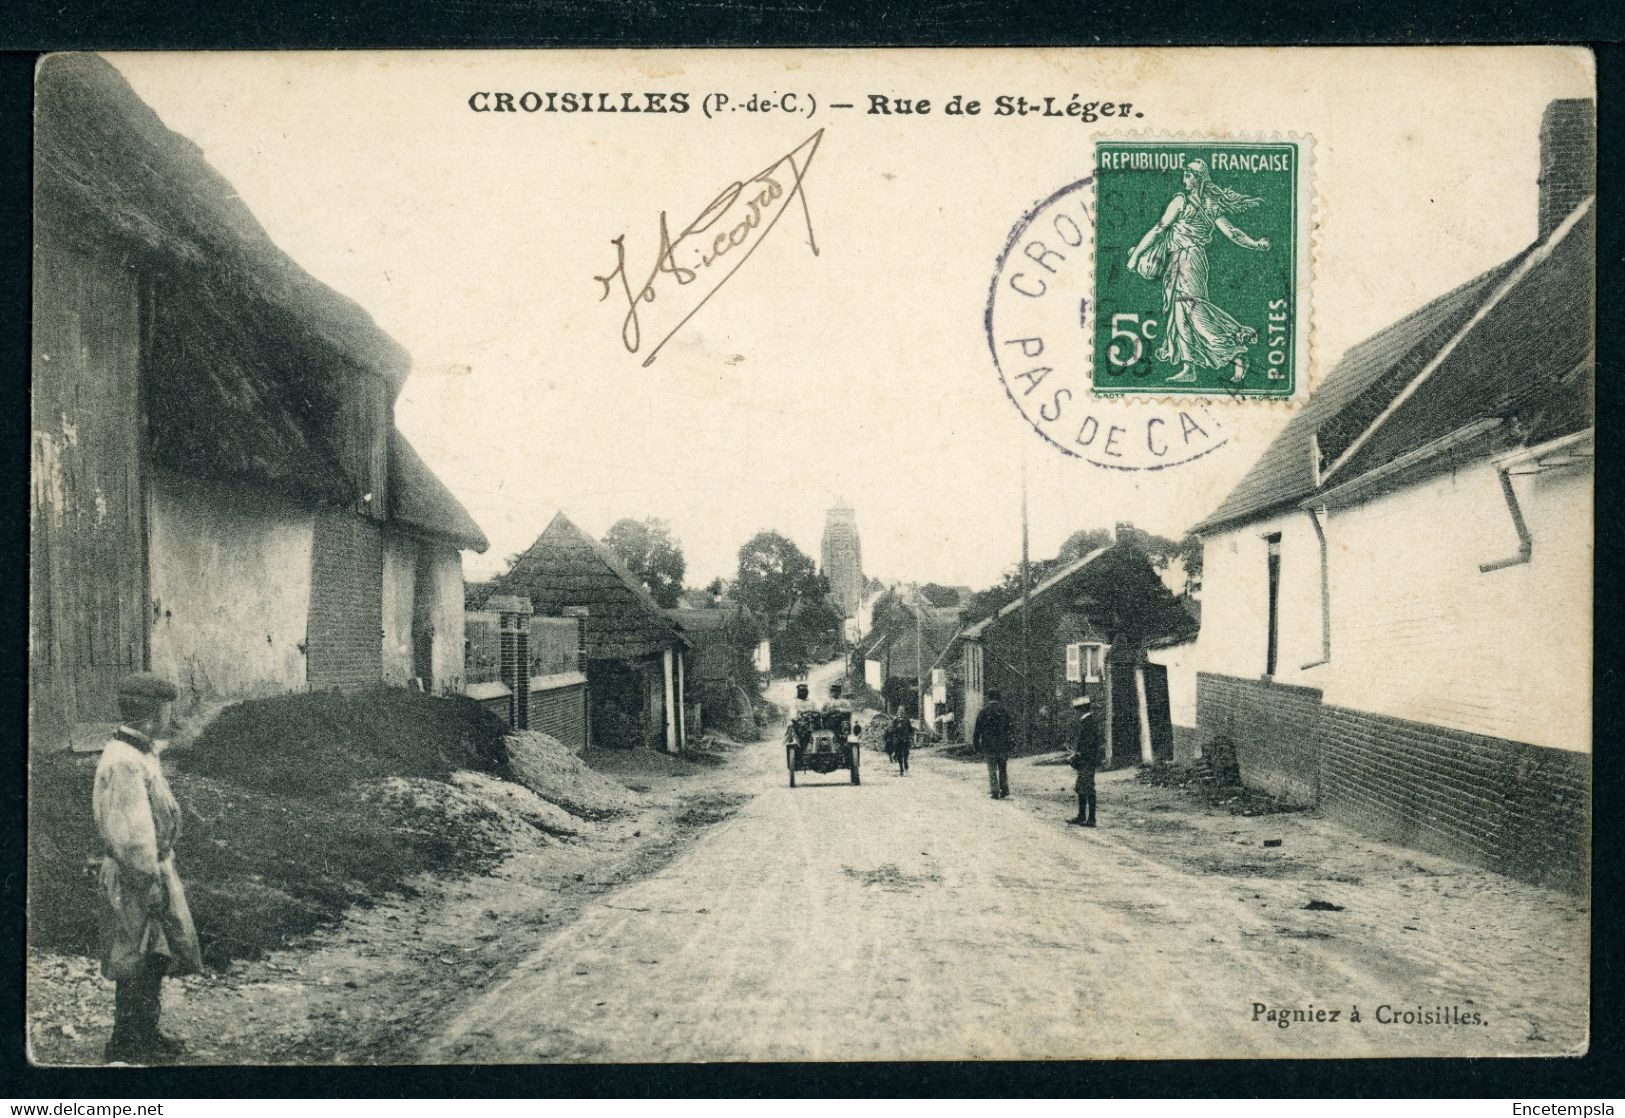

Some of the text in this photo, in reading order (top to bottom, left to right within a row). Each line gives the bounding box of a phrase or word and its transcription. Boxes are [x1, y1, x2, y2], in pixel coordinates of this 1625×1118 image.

[468, 91, 690, 114] CROISILLES
[702, 90, 817, 119] (P.-de-C.)
[867, 94, 931, 115] Rue
[944, 95, 981, 116] de
[993, 93, 1145, 123] St-Léger.
[1101, 151, 1289, 173] REPUBLIQUE FRANÇAISE
[1267, 298, 1288, 380] POSTES
[1005, 337, 1073, 422] PAS
[1075, 415, 1126, 457] DE
[1252, 1002, 1489, 1029] Pagniez à Croisilles.
